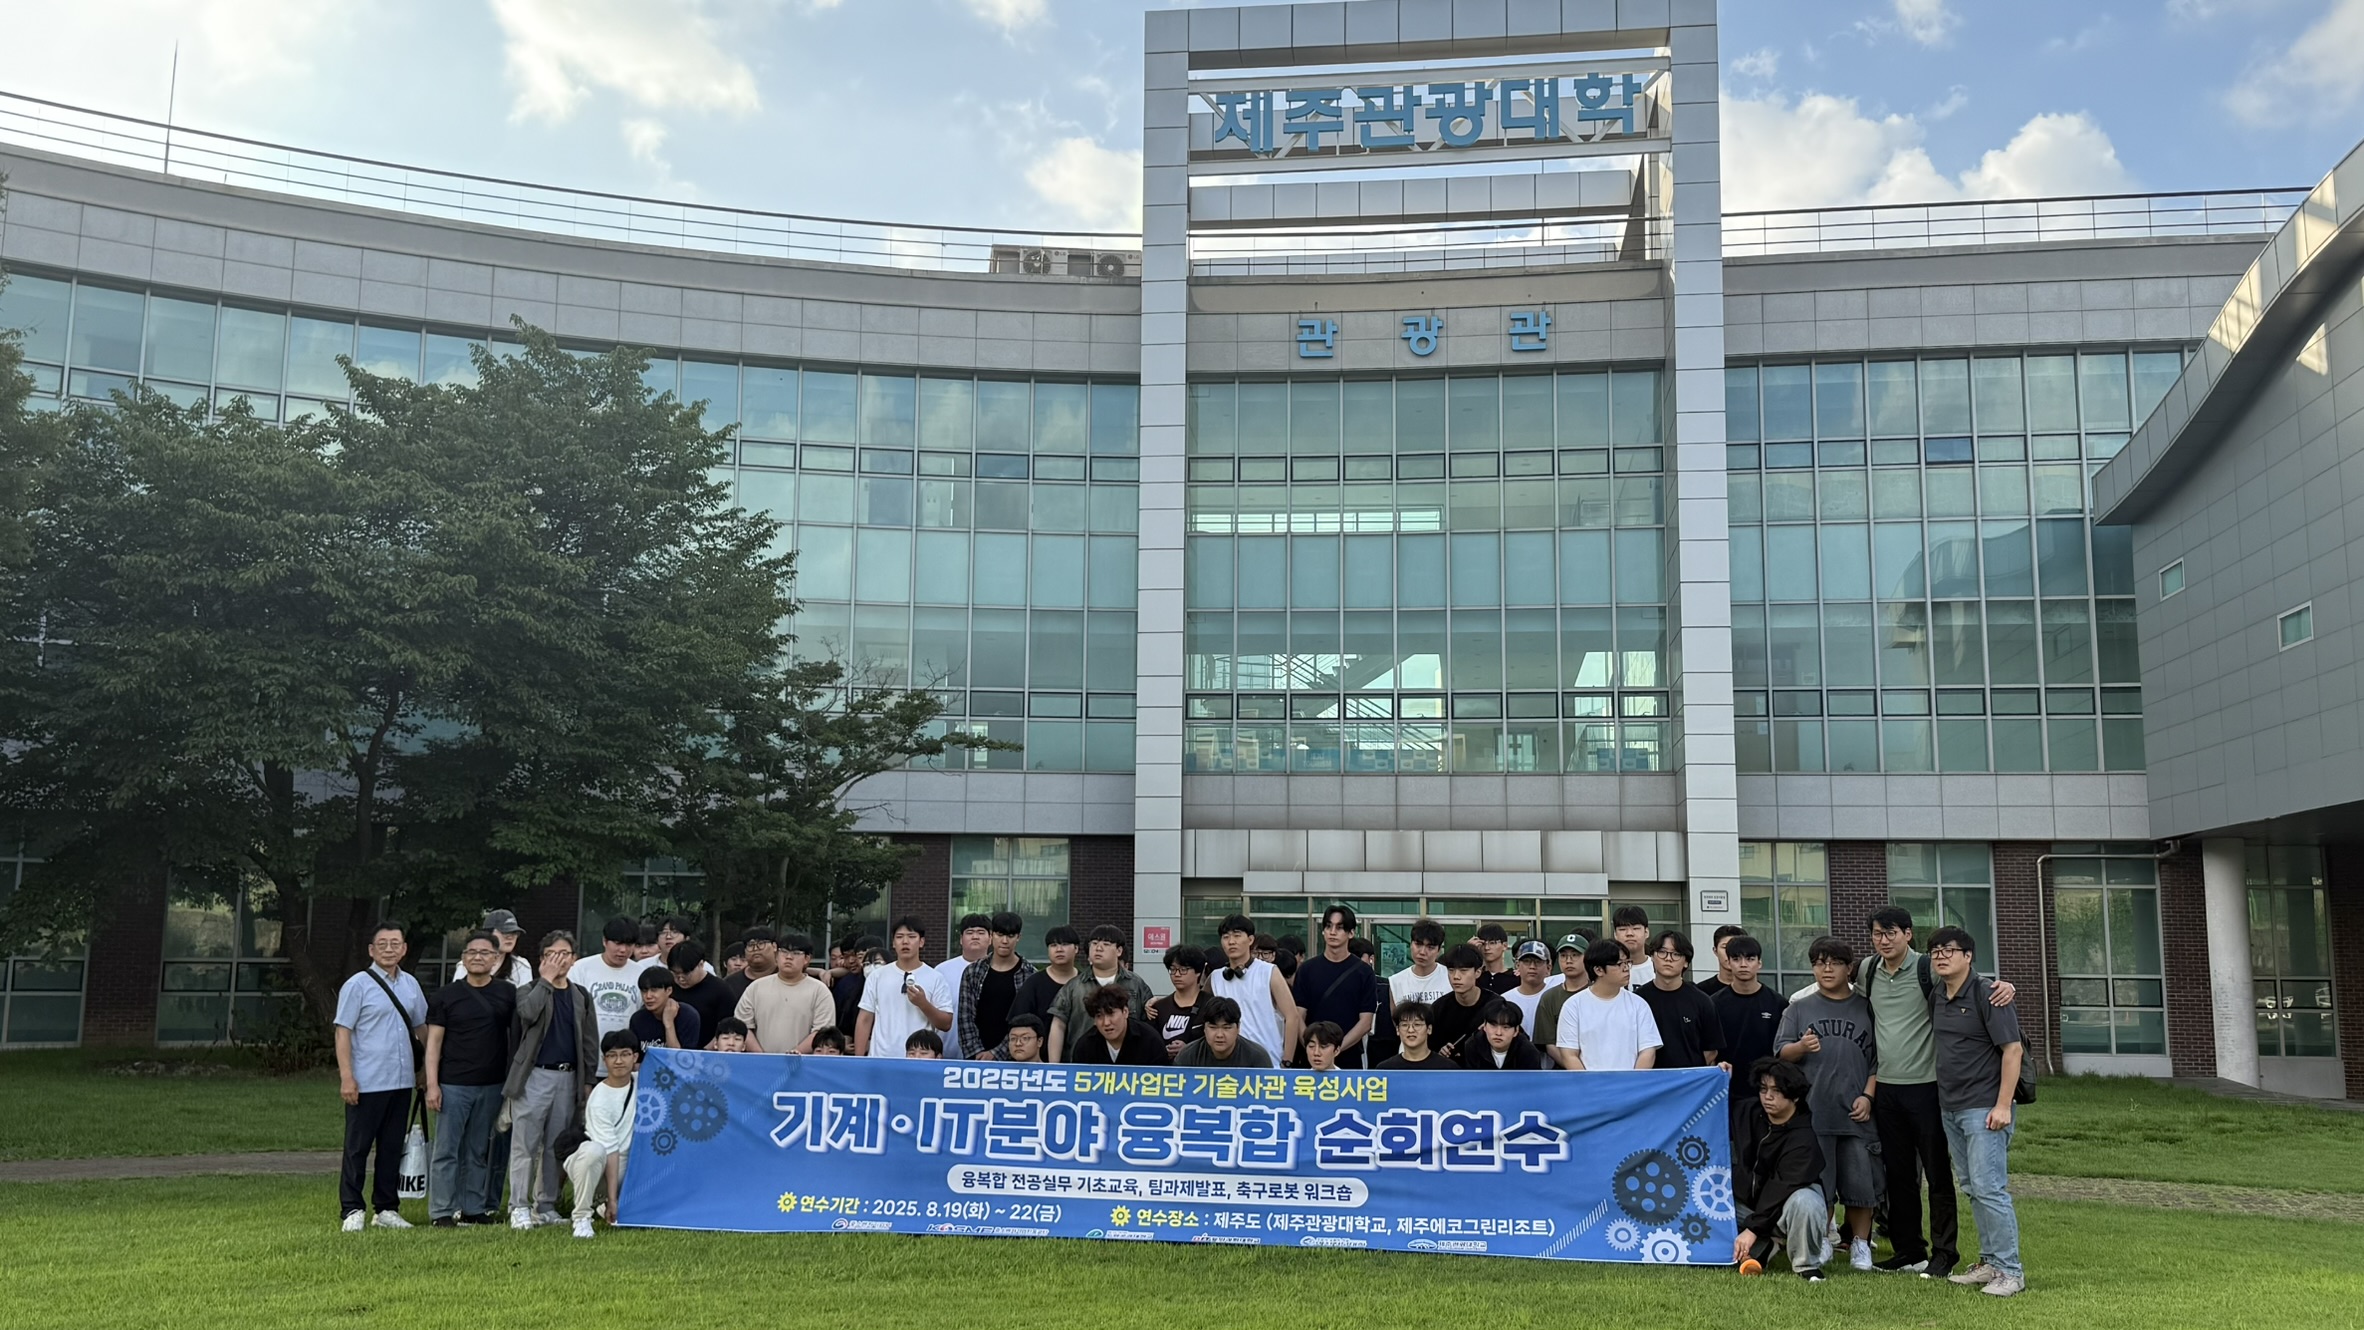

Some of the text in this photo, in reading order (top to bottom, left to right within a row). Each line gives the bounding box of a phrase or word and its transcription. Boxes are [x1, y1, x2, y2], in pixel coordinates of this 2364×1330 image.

[1214, 72, 1642, 153] 제주관광대학
[590, 981, 615, 999] GRAND
[1165, 1014, 1190, 1029] NIK
[1800, 1019, 1873, 1058] ATURAL
[943, 1066, 1389, 1102] 2025년도 5개사업단 기술사관 육성사업
[1117, 1101, 1302, 1169] 융복합
[1315, 1108, 1571, 1173] 순회연수
[398, 1174, 426, 1192] IKE
[962, 1171, 1353, 1201] 융복합 전공실무 기초교육, 팀과제발표, 축구로봇 워크숍
[800, 1195, 860, 1215] 연수기간
[872, 1199, 921, 1217] 2025.
[926, 1200, 990, 1221] 8.19(화)
[1010, 1203, 1062, 1223] 22(금)
[1137, 1209, 1199, 1228] 연수장소
[1214, 1211, 1261, 1230] 제주도
[1266, 1212, 1392, 1236] (제주관광대학교,
[1396, 1217, 1556, 1238] 제주에코그린리조트)
